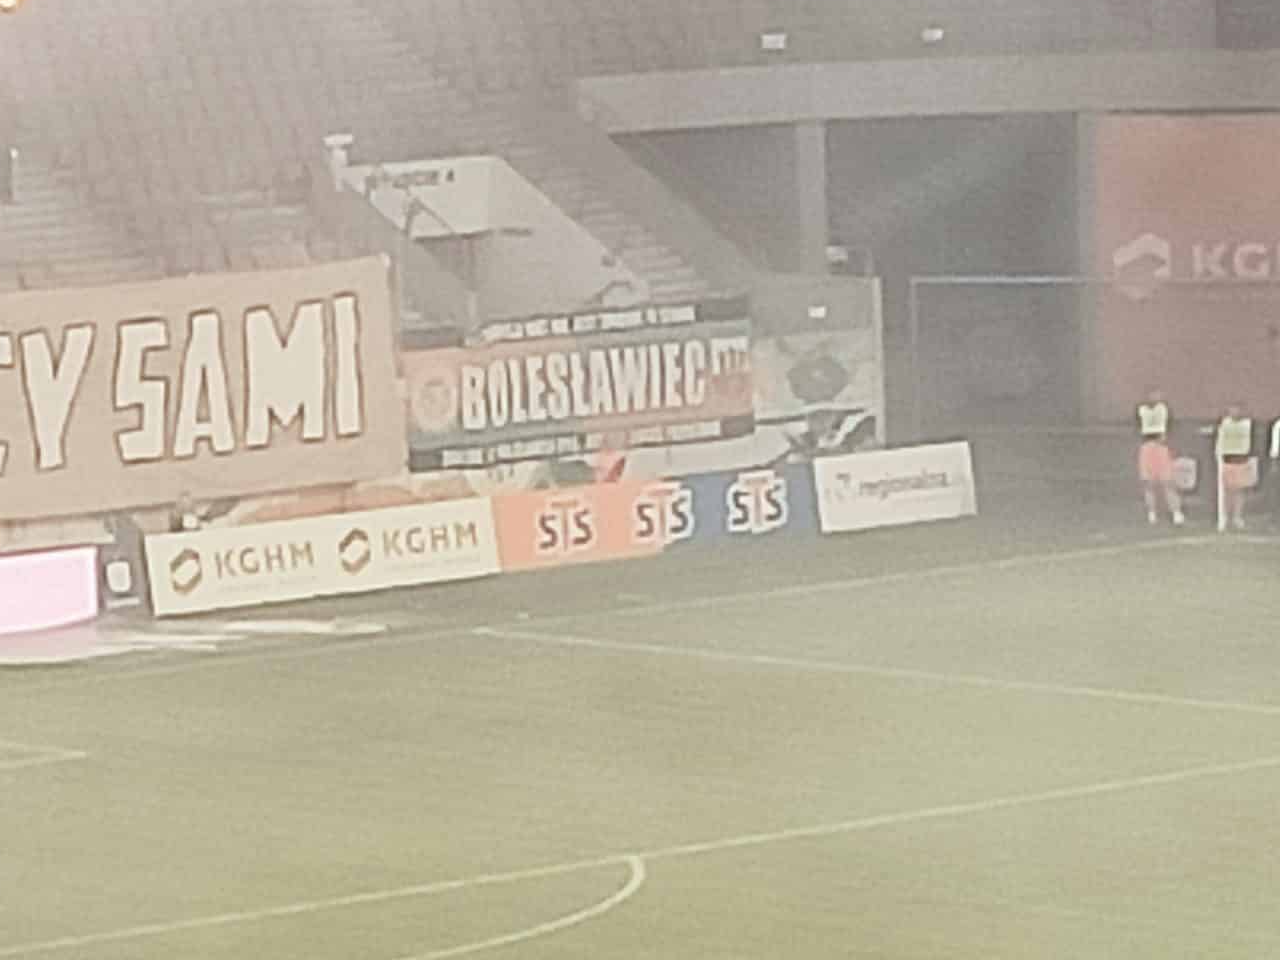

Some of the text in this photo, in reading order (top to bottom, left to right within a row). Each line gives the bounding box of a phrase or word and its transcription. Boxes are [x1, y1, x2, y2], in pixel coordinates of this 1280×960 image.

[1192, 243, 1280, 281] KG
[113, 292, 365, 463] SAMI
[461, 339, 707, 431] BOLESŁAWIEC
[538, 500, 593, 550] STS
[636, 489, 690, 537] STS
[731, 476, 783, 527] STS
[213, 521, 479, 581] KGHM KGHM
